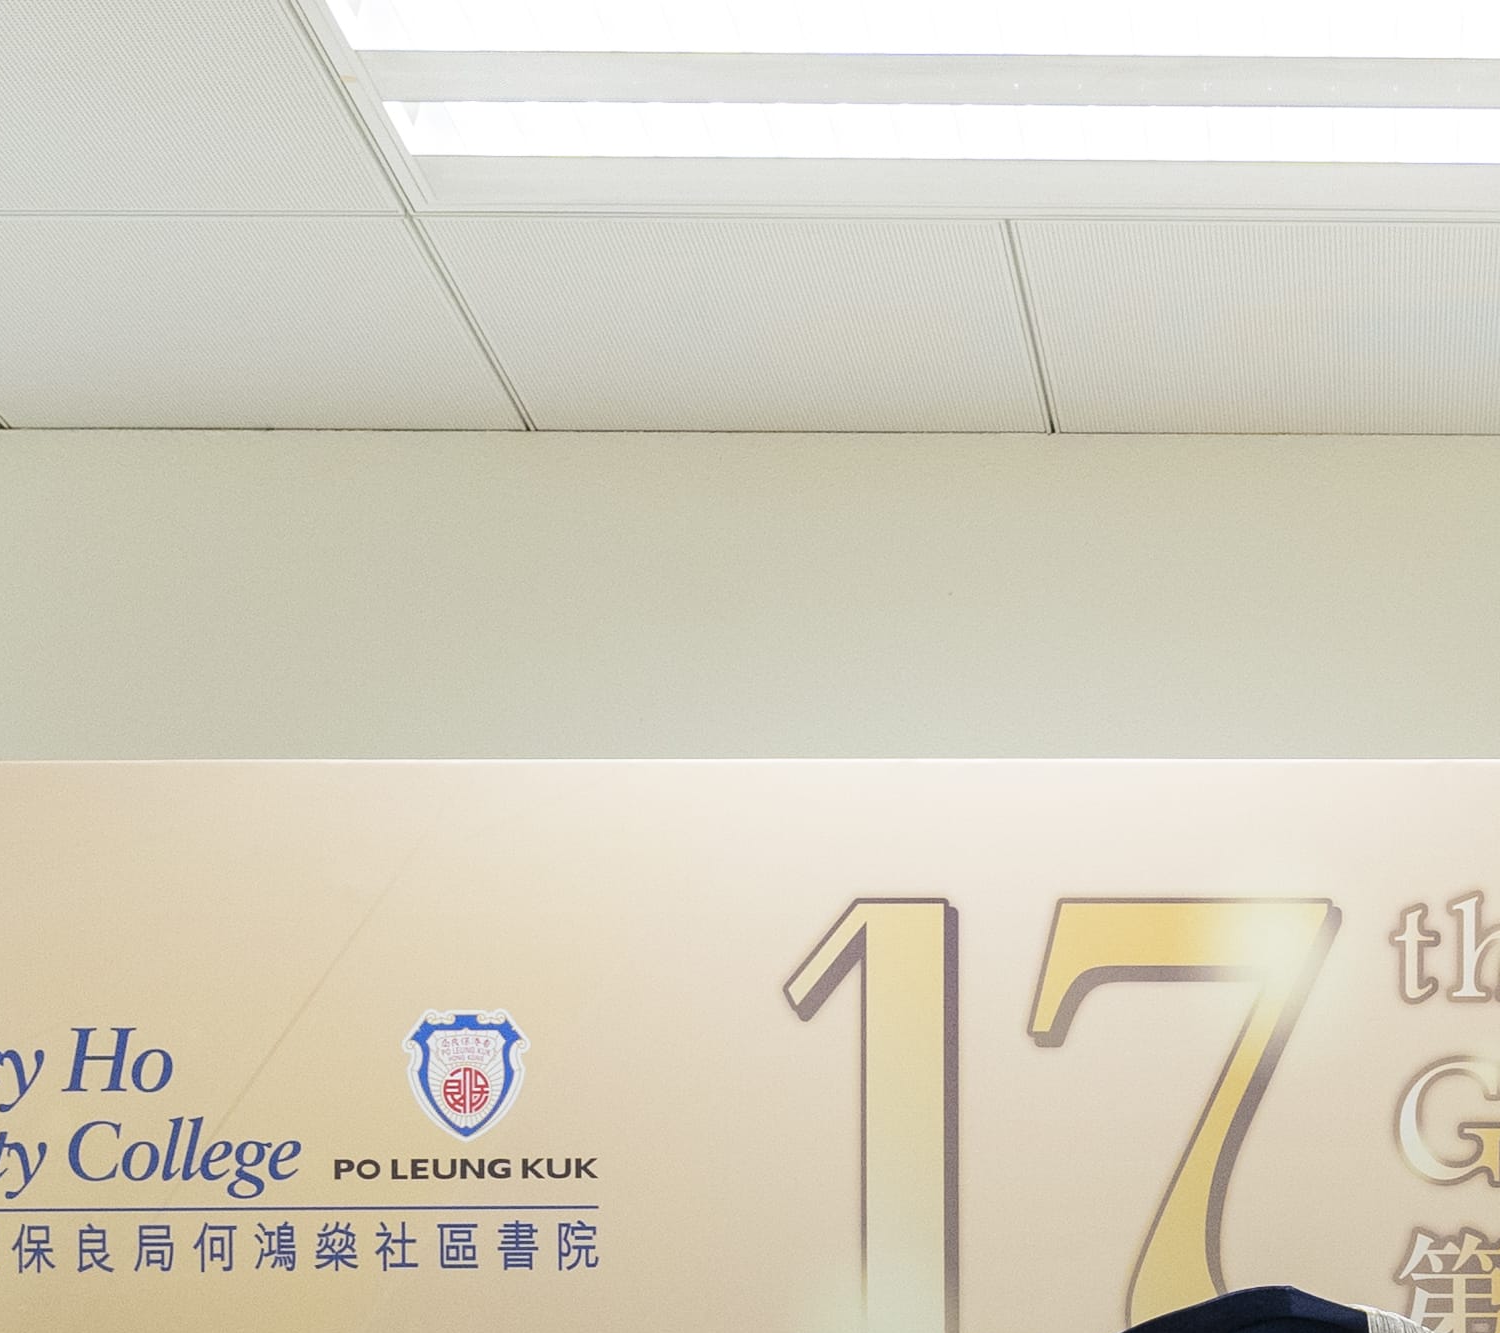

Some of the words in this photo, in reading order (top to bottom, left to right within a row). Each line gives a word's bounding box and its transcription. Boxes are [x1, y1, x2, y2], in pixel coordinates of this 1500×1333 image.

[61, 1027, 174, 1093] Ho
[67, 1115, 301, 1200] College
[333, 1158, 381, 1180] PO
[390, 1158, 512, 1180] LEUNG
[521, 1157, 598, 1180] KUK
